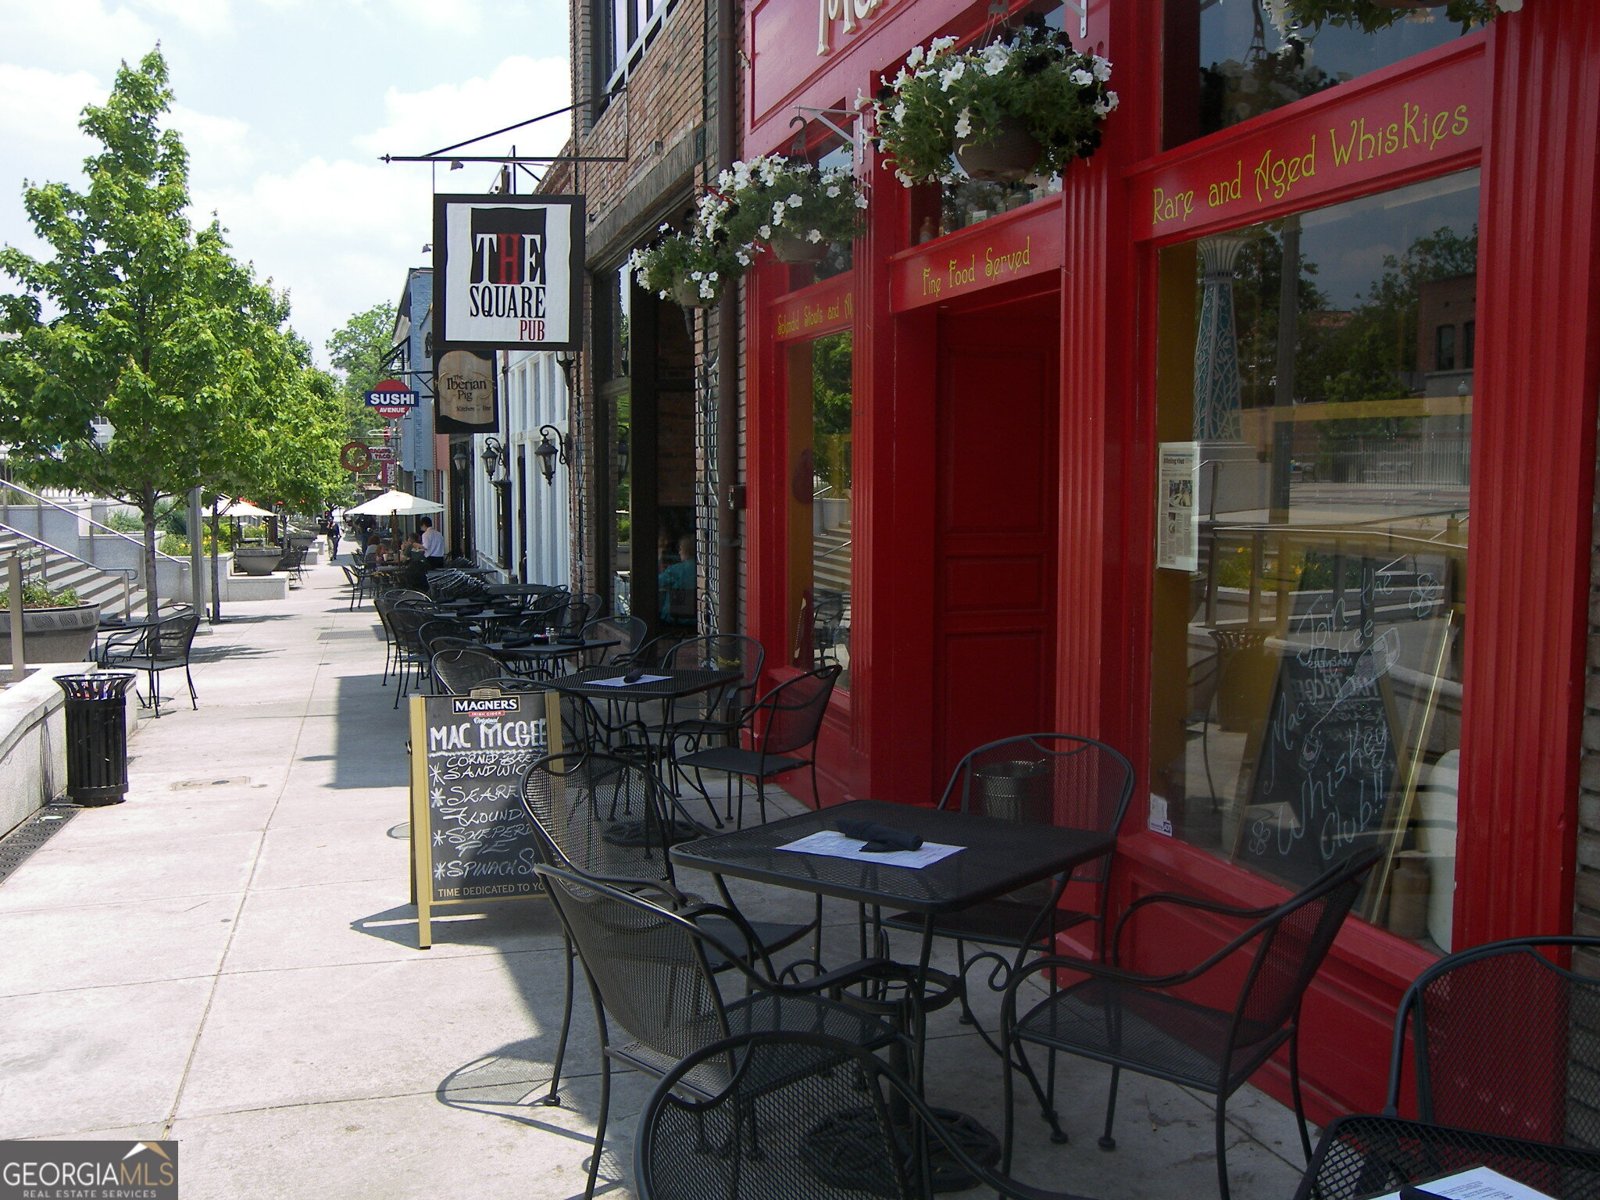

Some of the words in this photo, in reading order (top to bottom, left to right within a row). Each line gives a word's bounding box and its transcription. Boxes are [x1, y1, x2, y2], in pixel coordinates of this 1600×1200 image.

[1152, 188, 1194, 225] Rare
[1208, 160, 1242, 208] and
[1255, 135, 1316, 203] Aged
[476, 233, 541, 285] THE
[923, 267, 941, 297] Fine
[949, 254, 975, 288] Food
[985, 235, 1030, 280] Served
[469, 286, 546, 319] SQUARE
[519, 320, 545, 341] PUB
[447, 377, 487, 390] Iberian
[370, 393, 415, 405] SUSHI
[457, 390, 472, 401] Pig
[1360, 568, 1394, 607] the
[455, 699, 517, 712] MAGNERS
[430, 722, 472, 751] MAC
[480, 718, 547, 749] MCGEE
[443, 764, 527, 780] SANDWIC
[446, 785, 519, 806] SEARE
[439, 806, 525, 827] FLOUND
[455, 837, 517, 857] PIE
[446, 860, 517, 878] SPINACH
[438, 887, 460, 897] TIME
[463, 884, 515, 896] DEDICATED
[517, 883, 530, 892] TO
[532, 882, 545, 891] YO
